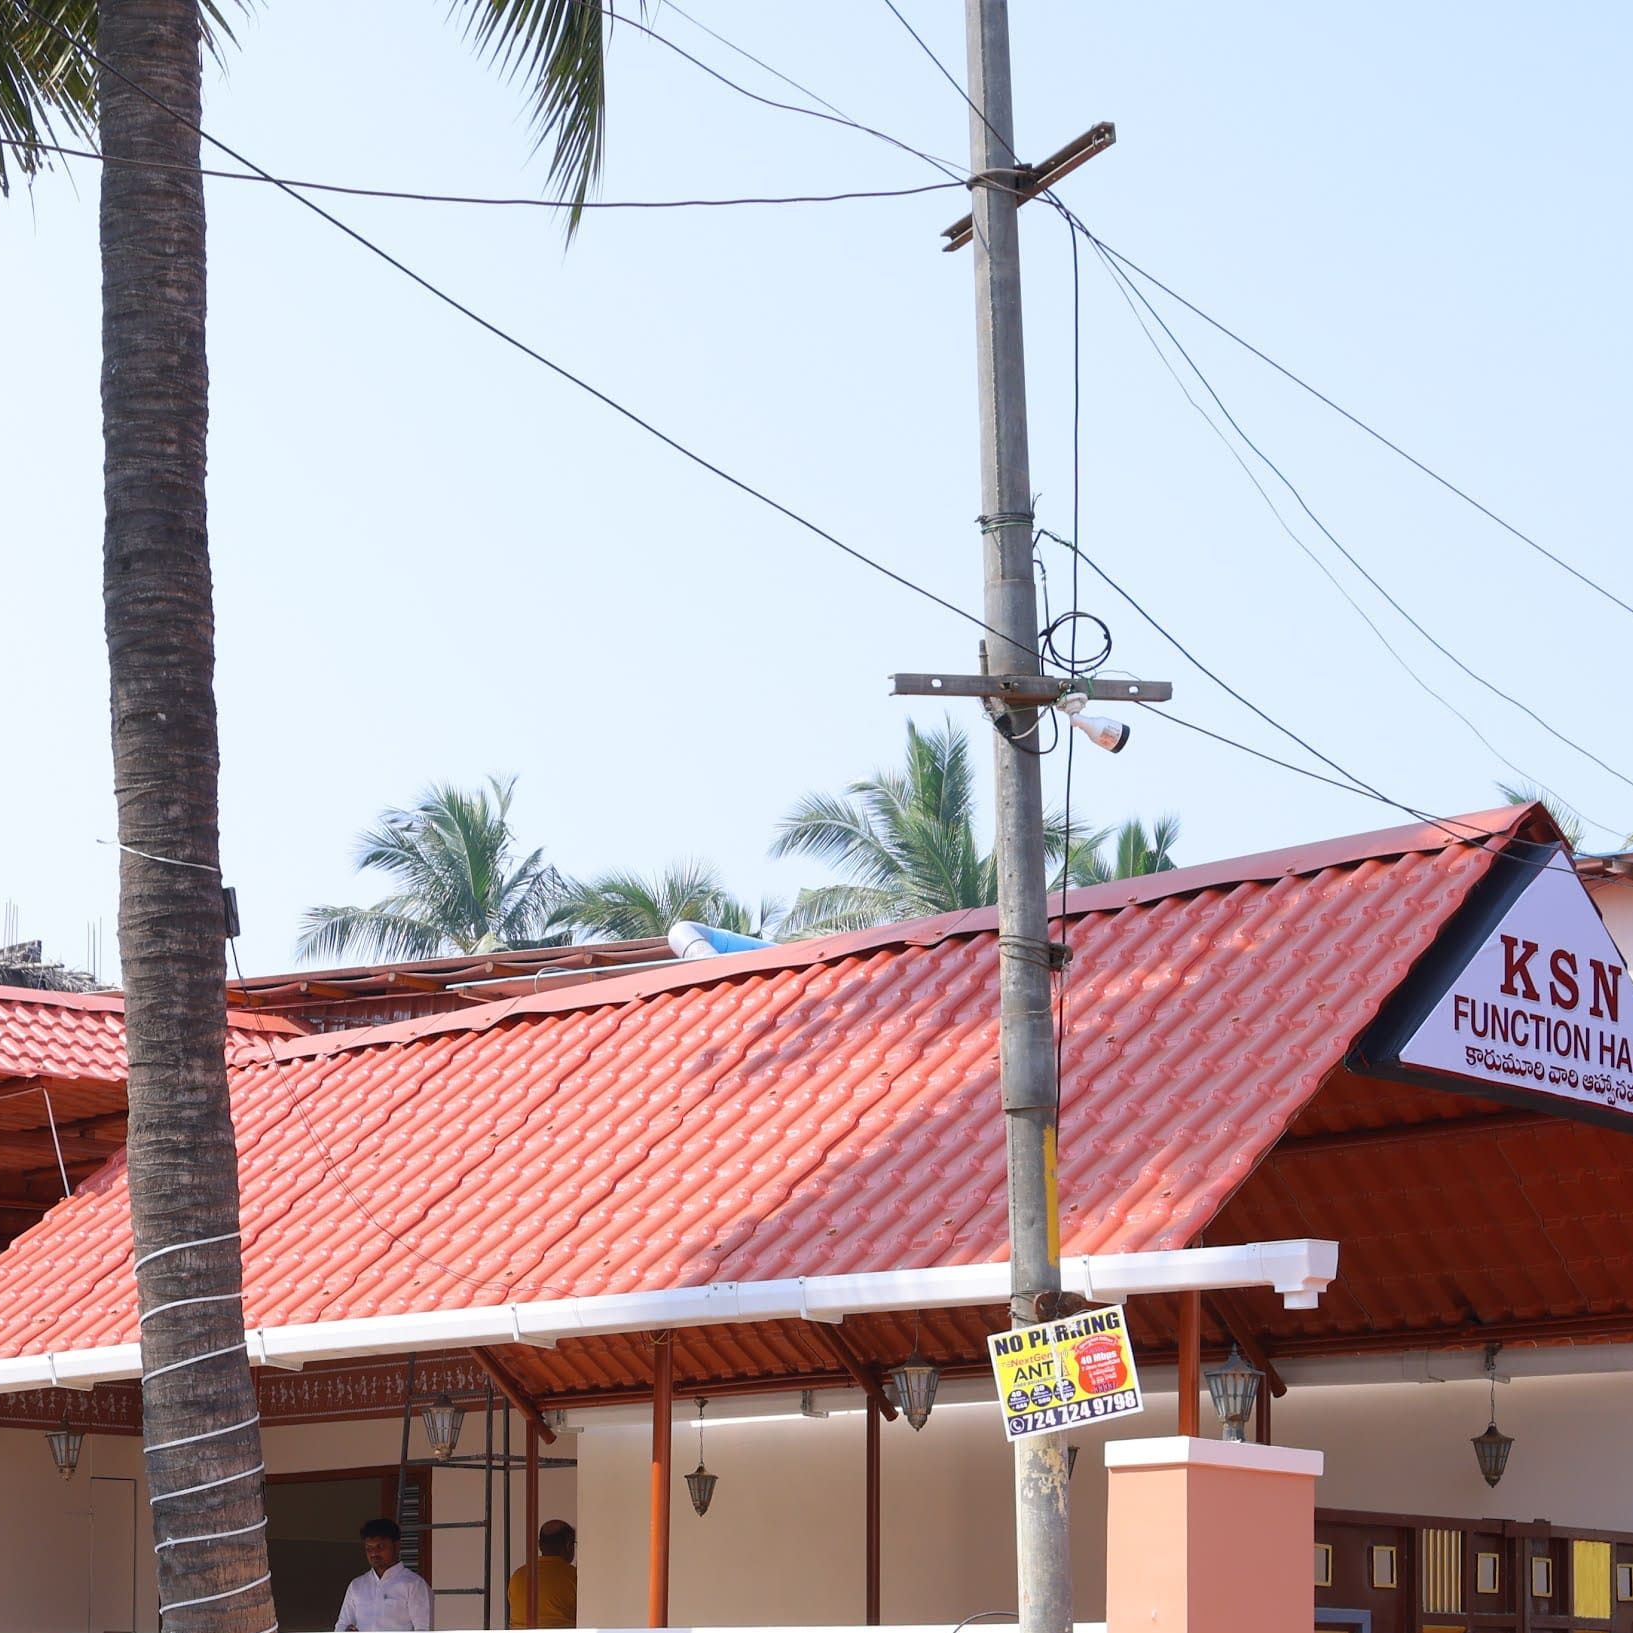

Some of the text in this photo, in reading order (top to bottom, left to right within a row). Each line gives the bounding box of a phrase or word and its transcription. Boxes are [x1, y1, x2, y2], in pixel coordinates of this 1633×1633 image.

[1500, 934, 1622, 1022] KSN
[1454, 994, 1590, 1062] FUNCTION
[1465, 1045, 1545, 1081] కారుమూరి
[1548, 1065, 1579, 1089] వారి
[994, 1335, 1023, 1357] NO
[1013, 1360, 1054, 1384] ANT
[1023, 1391, 1137, 1432] 724 724 9798
